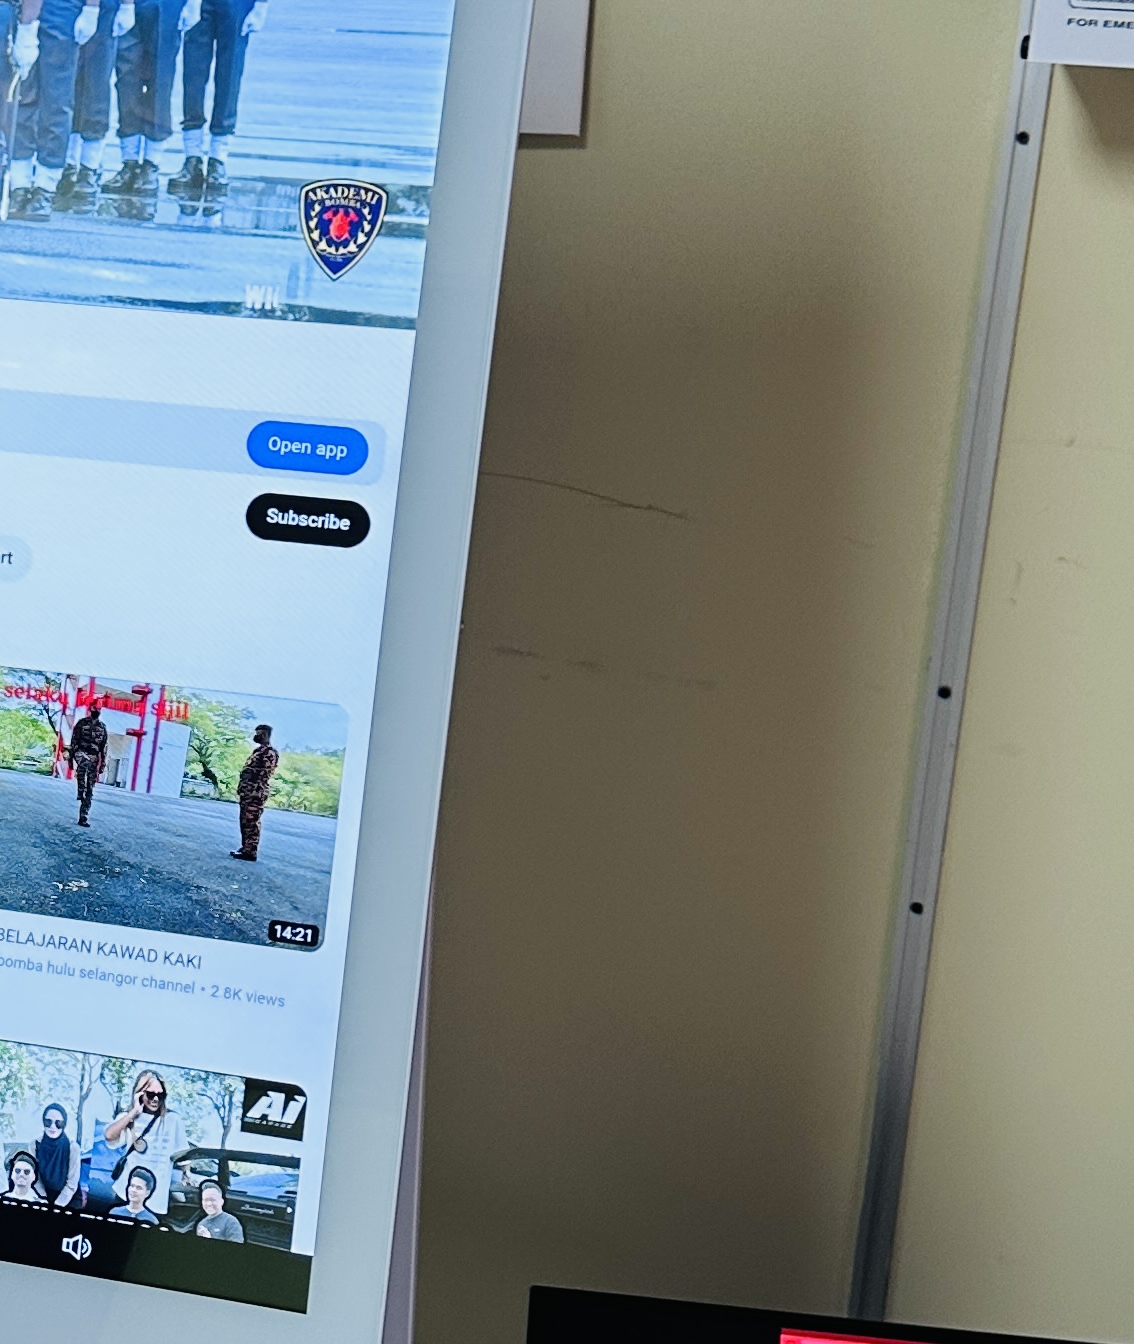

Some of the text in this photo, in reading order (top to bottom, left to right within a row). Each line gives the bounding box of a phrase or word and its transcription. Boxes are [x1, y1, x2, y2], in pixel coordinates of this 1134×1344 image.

[1067, 18, 1098, 26] FOR
[308, 186, 380, 204] AKADEMI
[268, 437, 347, 460] Open app
[266, 508, 350, 530] Subscribe
[274, 925, 313, 943] 14:21
[96, 941, 158, 962] KAWAD
[163, 950, 202, 969] KAKI
[47, 959, 76, 977] hulu
[79, 966, 138, 987] selangor
[141, 974, 195, 994] channel
[246, 990, 285, 1007] views
